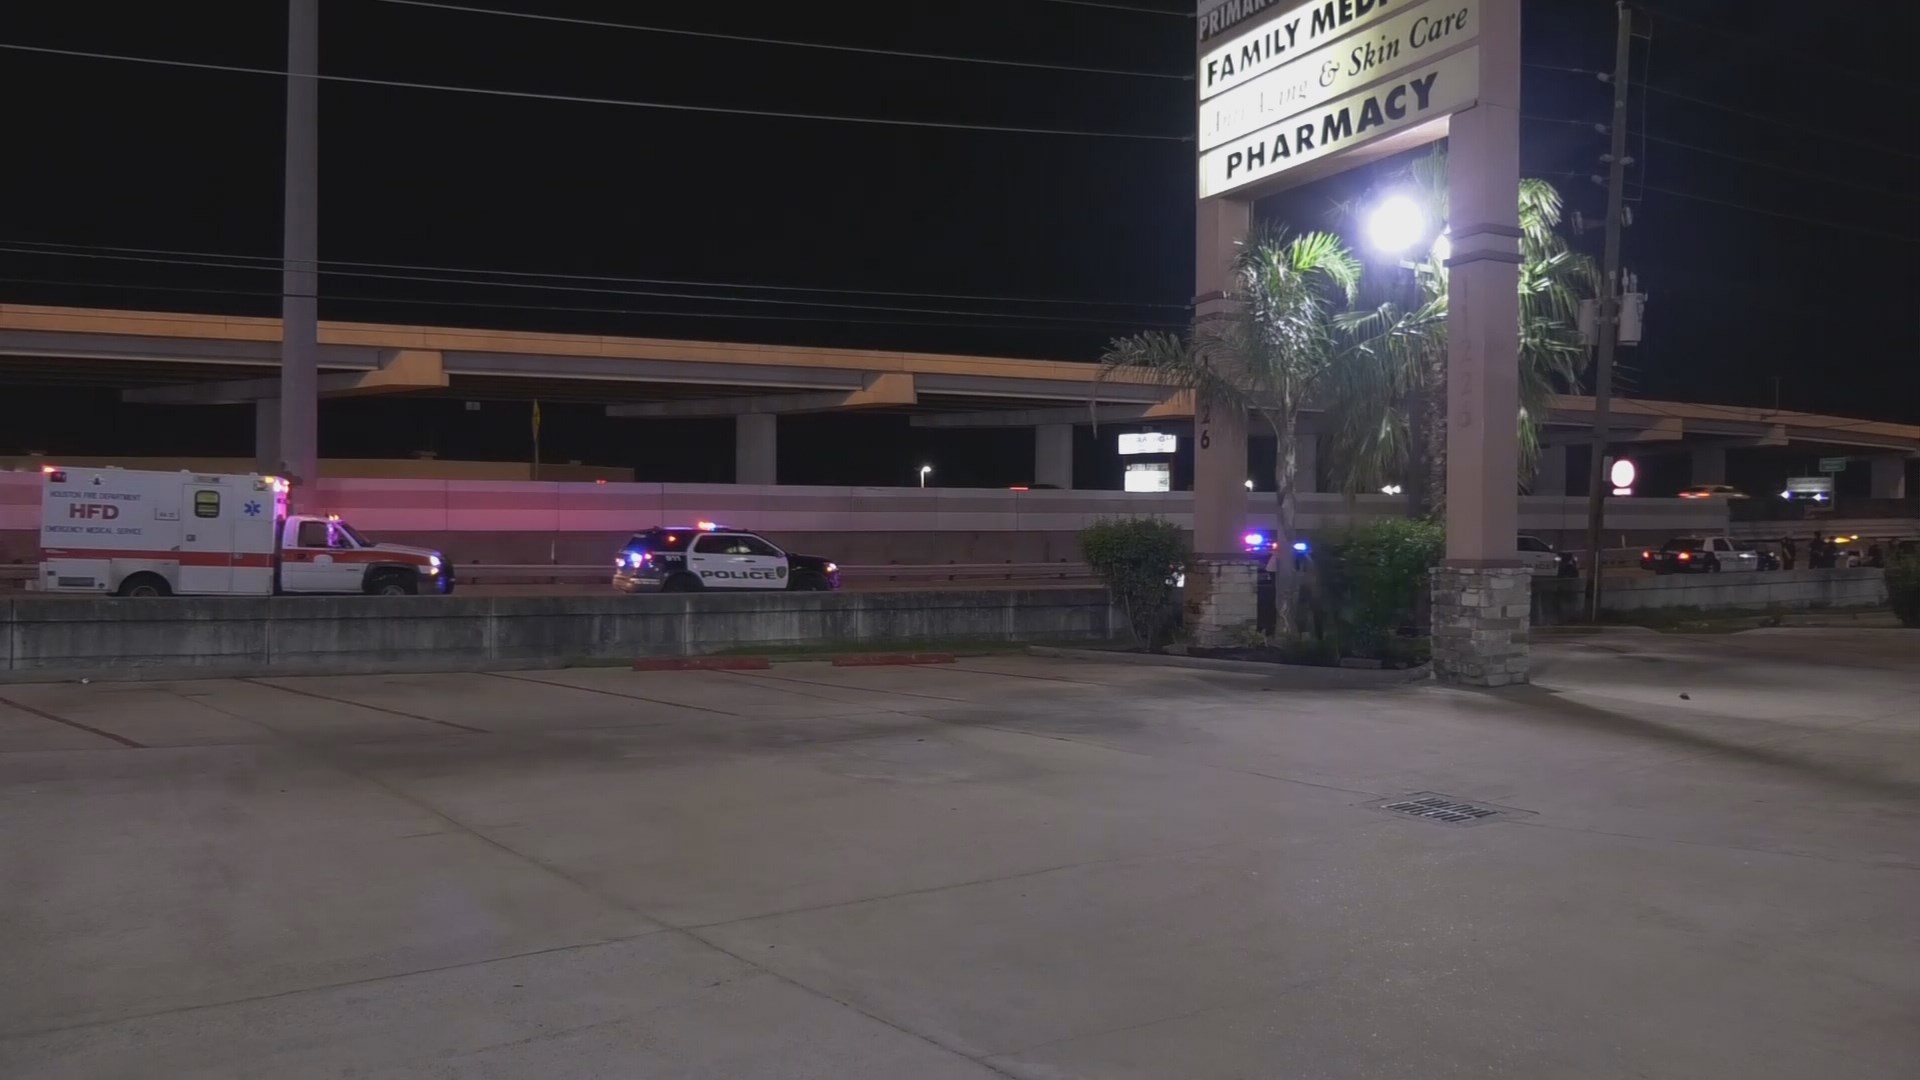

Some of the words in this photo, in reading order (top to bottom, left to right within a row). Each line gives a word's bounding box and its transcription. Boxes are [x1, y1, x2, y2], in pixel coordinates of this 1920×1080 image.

[1200, 0, 1279, 40] PRIMA
[1207, 18, 1301, 88] FAMILY
[1319, 60, 1340, 87] &
[1348, 38, 1400, 77] Skin
[1409, 7, 1468, 49] Care
[1226, 71, 1438, 180] PHARMACY
[69, 503, 119, 520] HFD
[86, 526, 112, 534] MEDICAL
[700, 570, 777, 580] POLICE
